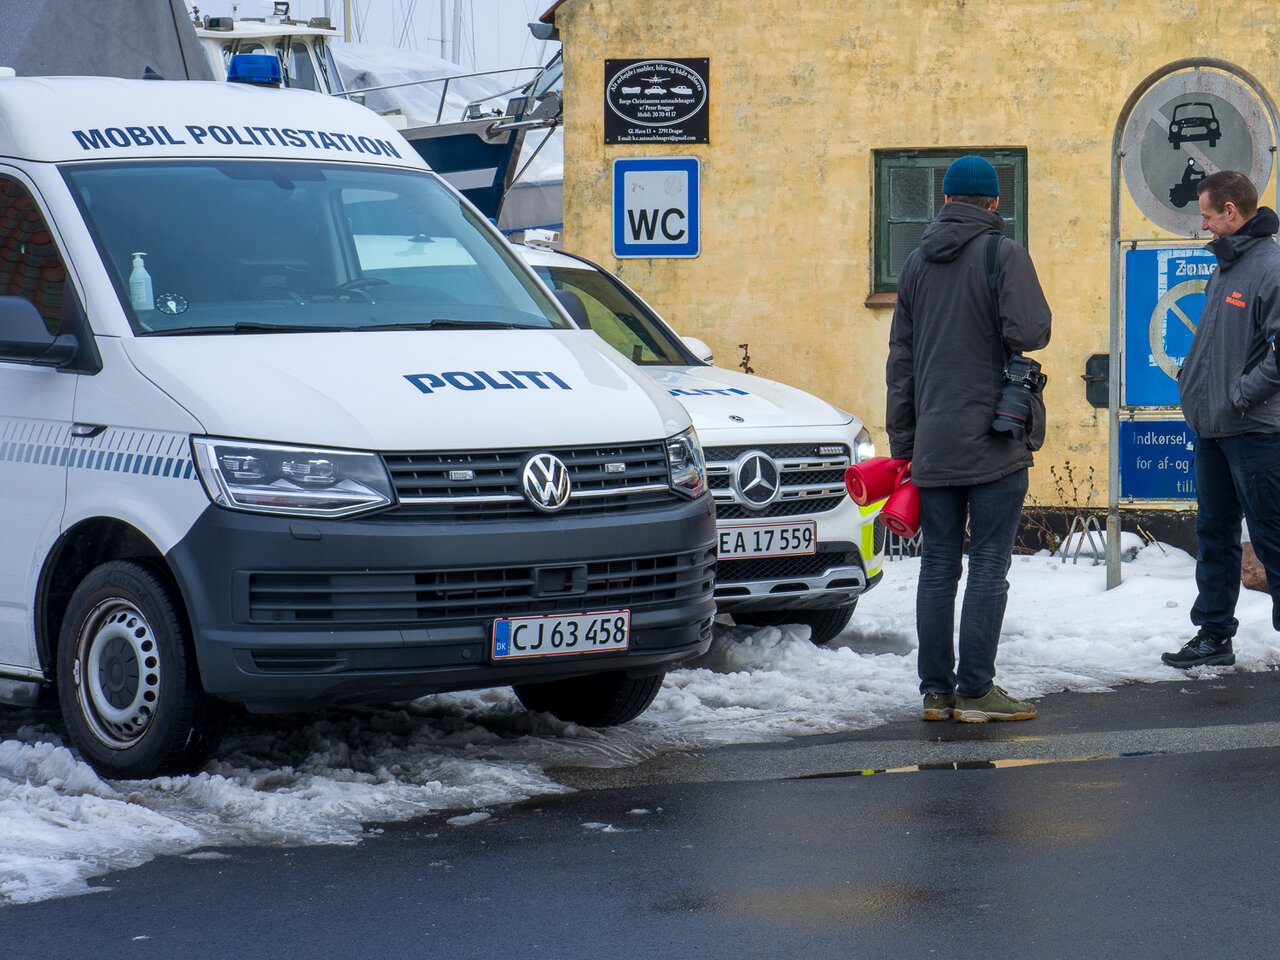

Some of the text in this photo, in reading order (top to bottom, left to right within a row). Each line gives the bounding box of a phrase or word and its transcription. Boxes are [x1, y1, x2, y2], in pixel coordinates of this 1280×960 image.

[71, 125, 403, 159] MOBIL POLITISTATION
[627, 207, 686, 241] WC
[402, 370, 573, 394] POLITI
[667, 388, 750, 396] LITI
[1133, 431, 1186, 445] Indkørsel
[1136, 456, 1152, 469] for
[1176, 479, 1196, 493] till
[719, 527, 812, 554] EA 17 559
[496, 616, 626, 651] DK CJ 63 458
